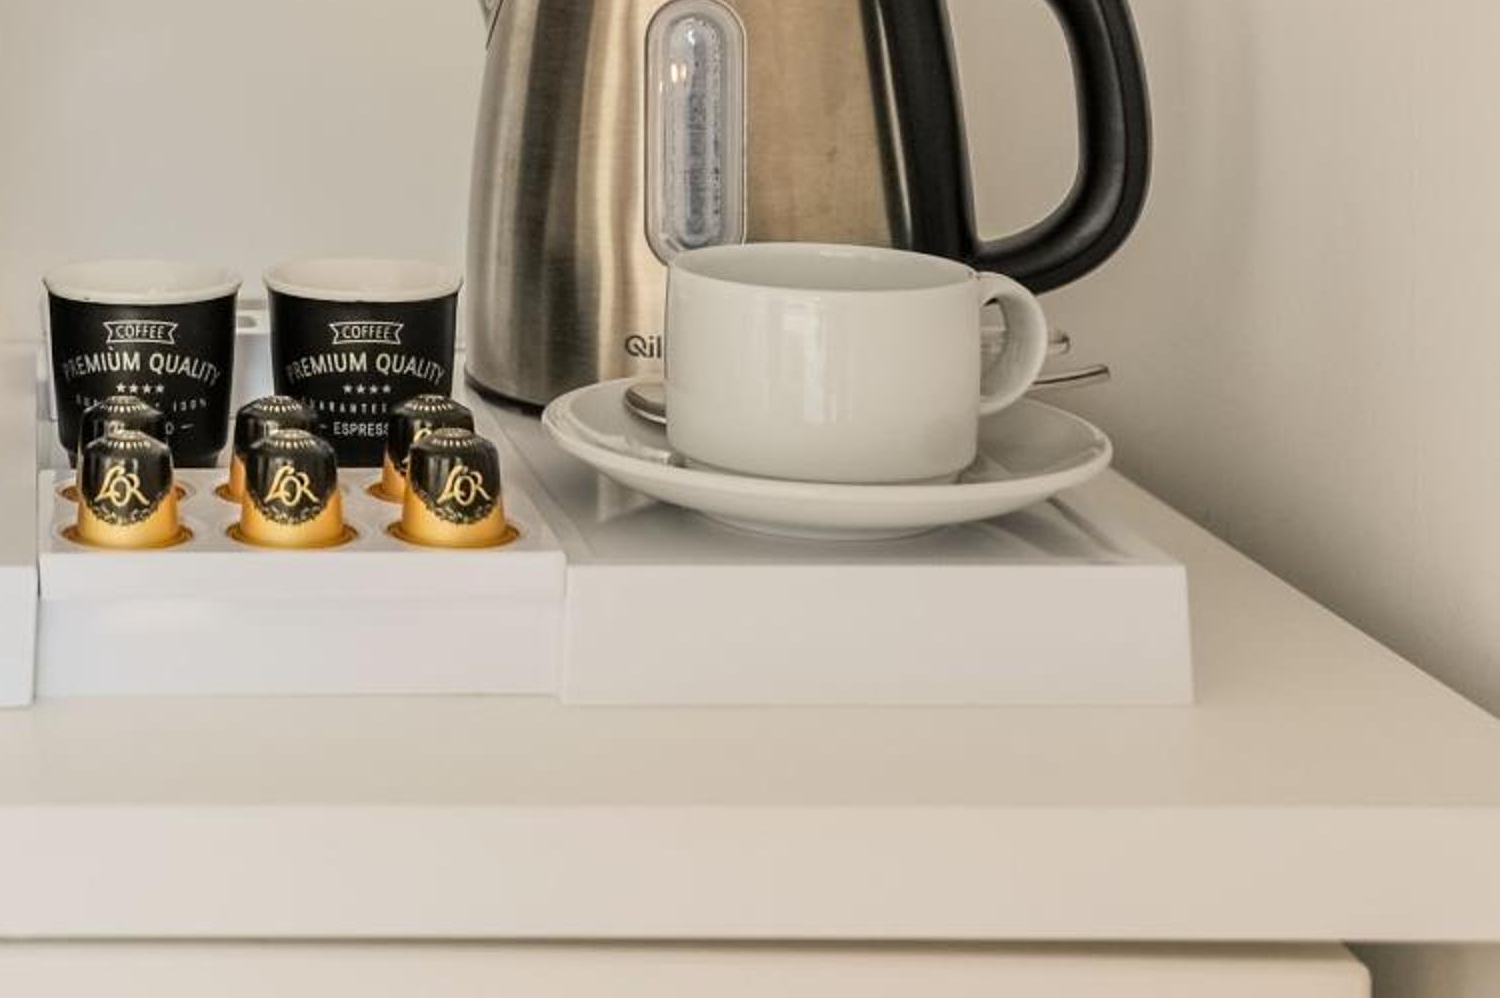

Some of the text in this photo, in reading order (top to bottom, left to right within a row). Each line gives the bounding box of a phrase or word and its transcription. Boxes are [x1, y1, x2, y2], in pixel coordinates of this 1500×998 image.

[115, 325, 164, 339] COFFEE
[341, 325, 390, 339] COFFEE
[625, 335, 662, 358] Qil
[63, 351, 220, 386] PREMIUM QUALITY
[286, 352, 446, 385] PREMIUM QUALITY
[333, 421, 388, 436] ESPRESS
